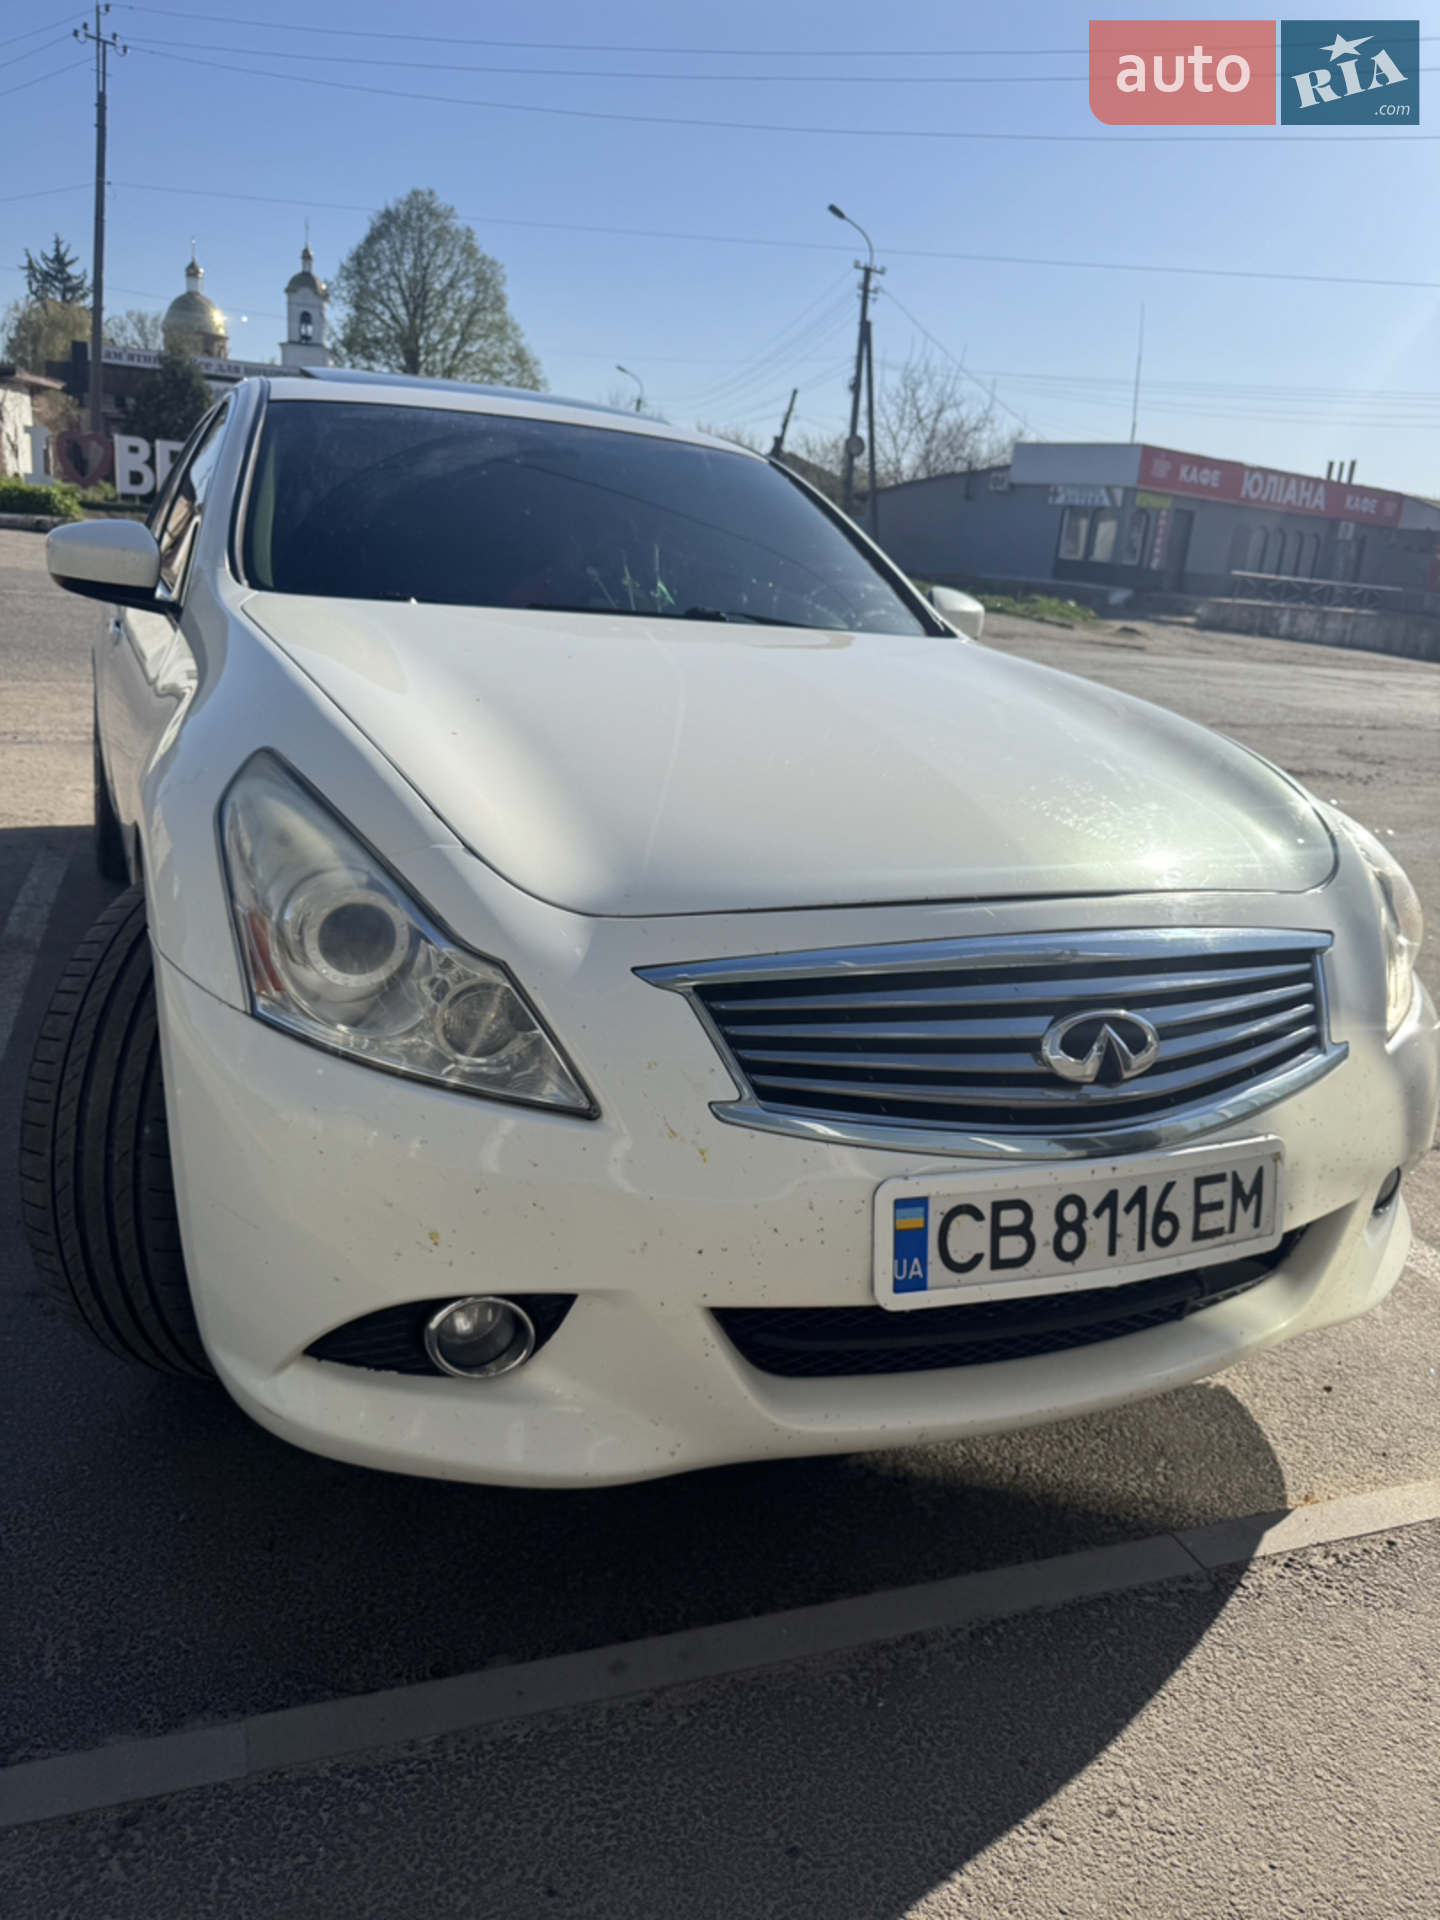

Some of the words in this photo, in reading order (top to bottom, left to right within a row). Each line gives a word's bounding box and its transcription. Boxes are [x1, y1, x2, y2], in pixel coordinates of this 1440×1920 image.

[1179, 464, 1221, 488] КАФЕ
[1240, 469, 1327, 512] ЮЛІАНА
[1344, 494, 1379, 514] КАФЕ
[938, 1199, 1036, 1274] CB
[1053, 1181, 1180, 1263] 8116
[1192, 1165, 1264, 1242] EM
[894, 1257, 924, 1281] UA
